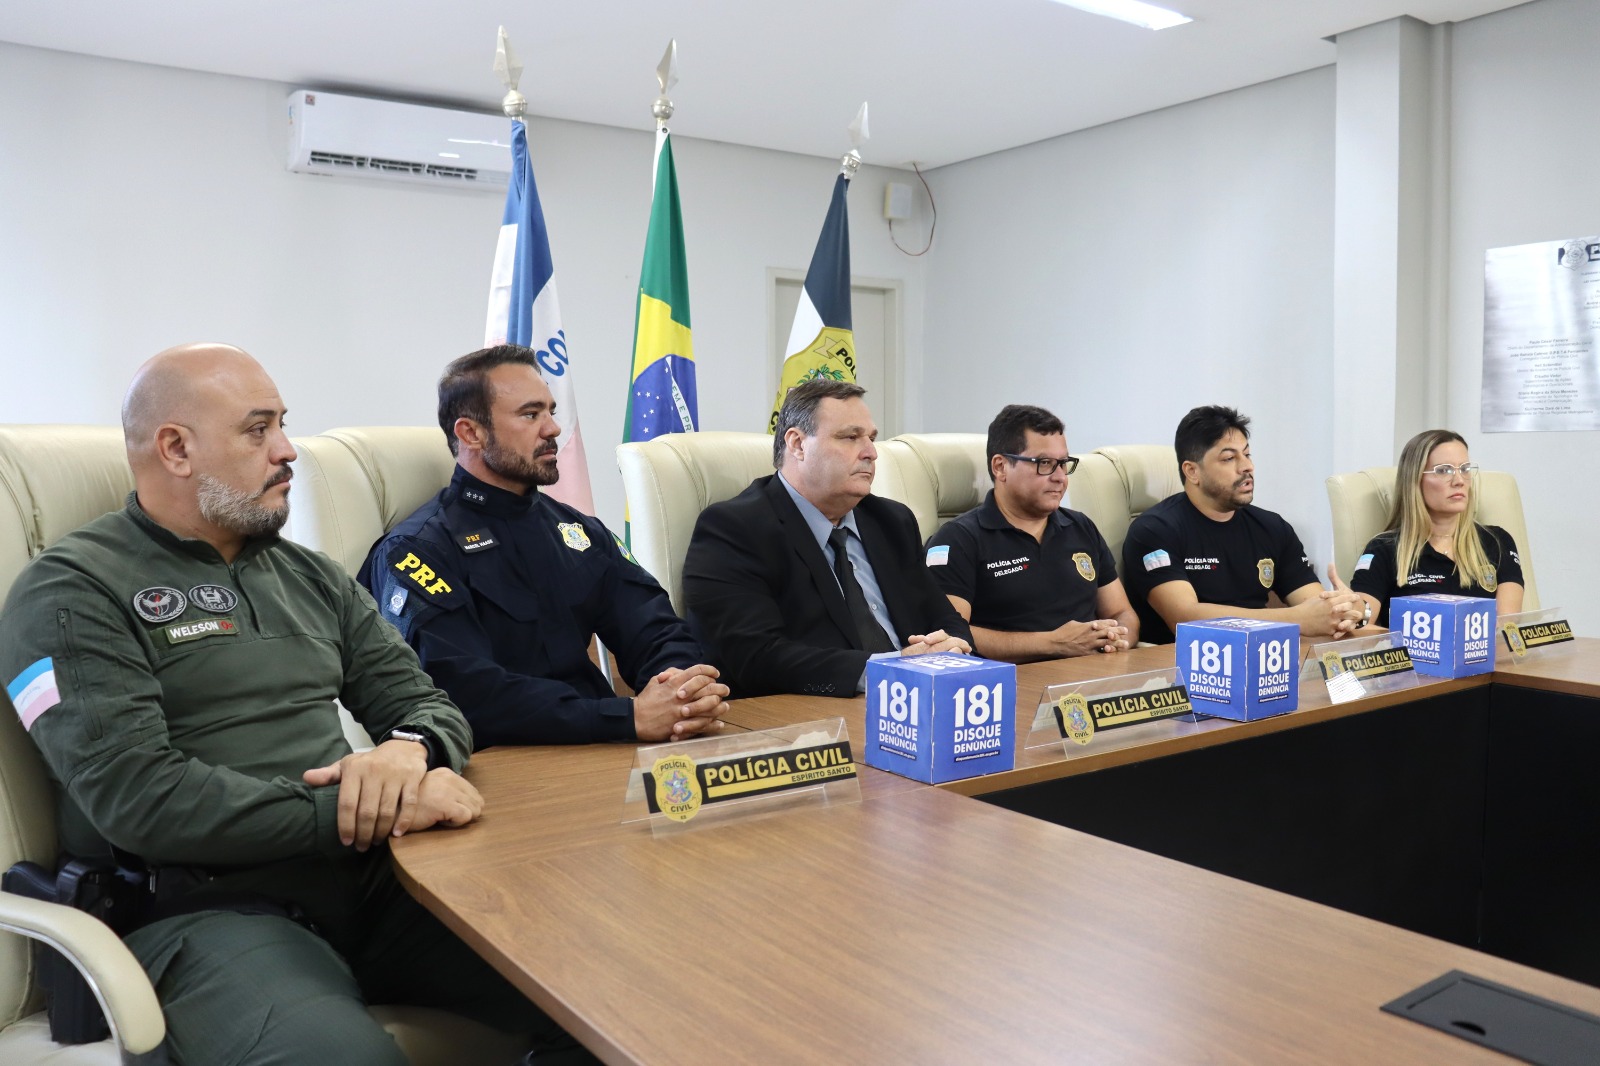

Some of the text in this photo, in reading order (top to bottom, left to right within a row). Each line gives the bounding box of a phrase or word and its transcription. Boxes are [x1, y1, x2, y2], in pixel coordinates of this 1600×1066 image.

[466, 534, 480, 543] PRF
[986, 556, 1030, 570] POLÍCIA CIVIL
[994, 565, 1024, 578] DELEGADO
[394, 552, 453, 595] PRF
[169, 621, 219, 639] WELESON
[1401, 610, 1442, 641] 181
[1463, 611, 1489, 641] 181
[1521, 622, 1570, 639] POLÍCIA CIVIL
[1403, 638, 1441, 652] DISQUE
[1407, 648, 1440, 659] ENÚNCIA
[1464, 639, 1489, 652] DISQUE
[1189, 639, 1232, 676] 181
[1258, 638, 1290, 675] 181
[1345, 650, 1409, 671] POLÍCIA CIVIL
[1190, 672, 1232, 688] DISQUE
[1258, 672, 1290, 687] DISQUE
[1189, 683, 1231, 697] DENÚNCIA
[1258, 684, 1289, 696] DENÚNCIA
[877, 679, 919, 726] 181
[952, 682, 1003, 728] 181
[1092, 690, 1187, 718] POLÍCIA CIVIL
[879, 718, 918, 742] DISQUE
[954, 724, 1002, 743] DISQUE
[879, 732, 917, 752] DENÚNCIA
[953, 737, 1001, 754] DENÚNCIA
[660, 761, 688, 772] POLÍCIA
[703, 747, 849, 786] POLÍCIA CIVIL
[791, 766, 851, 783] ESPÍRITO SANTO
[670, 803, 692, 813] CIVIL
